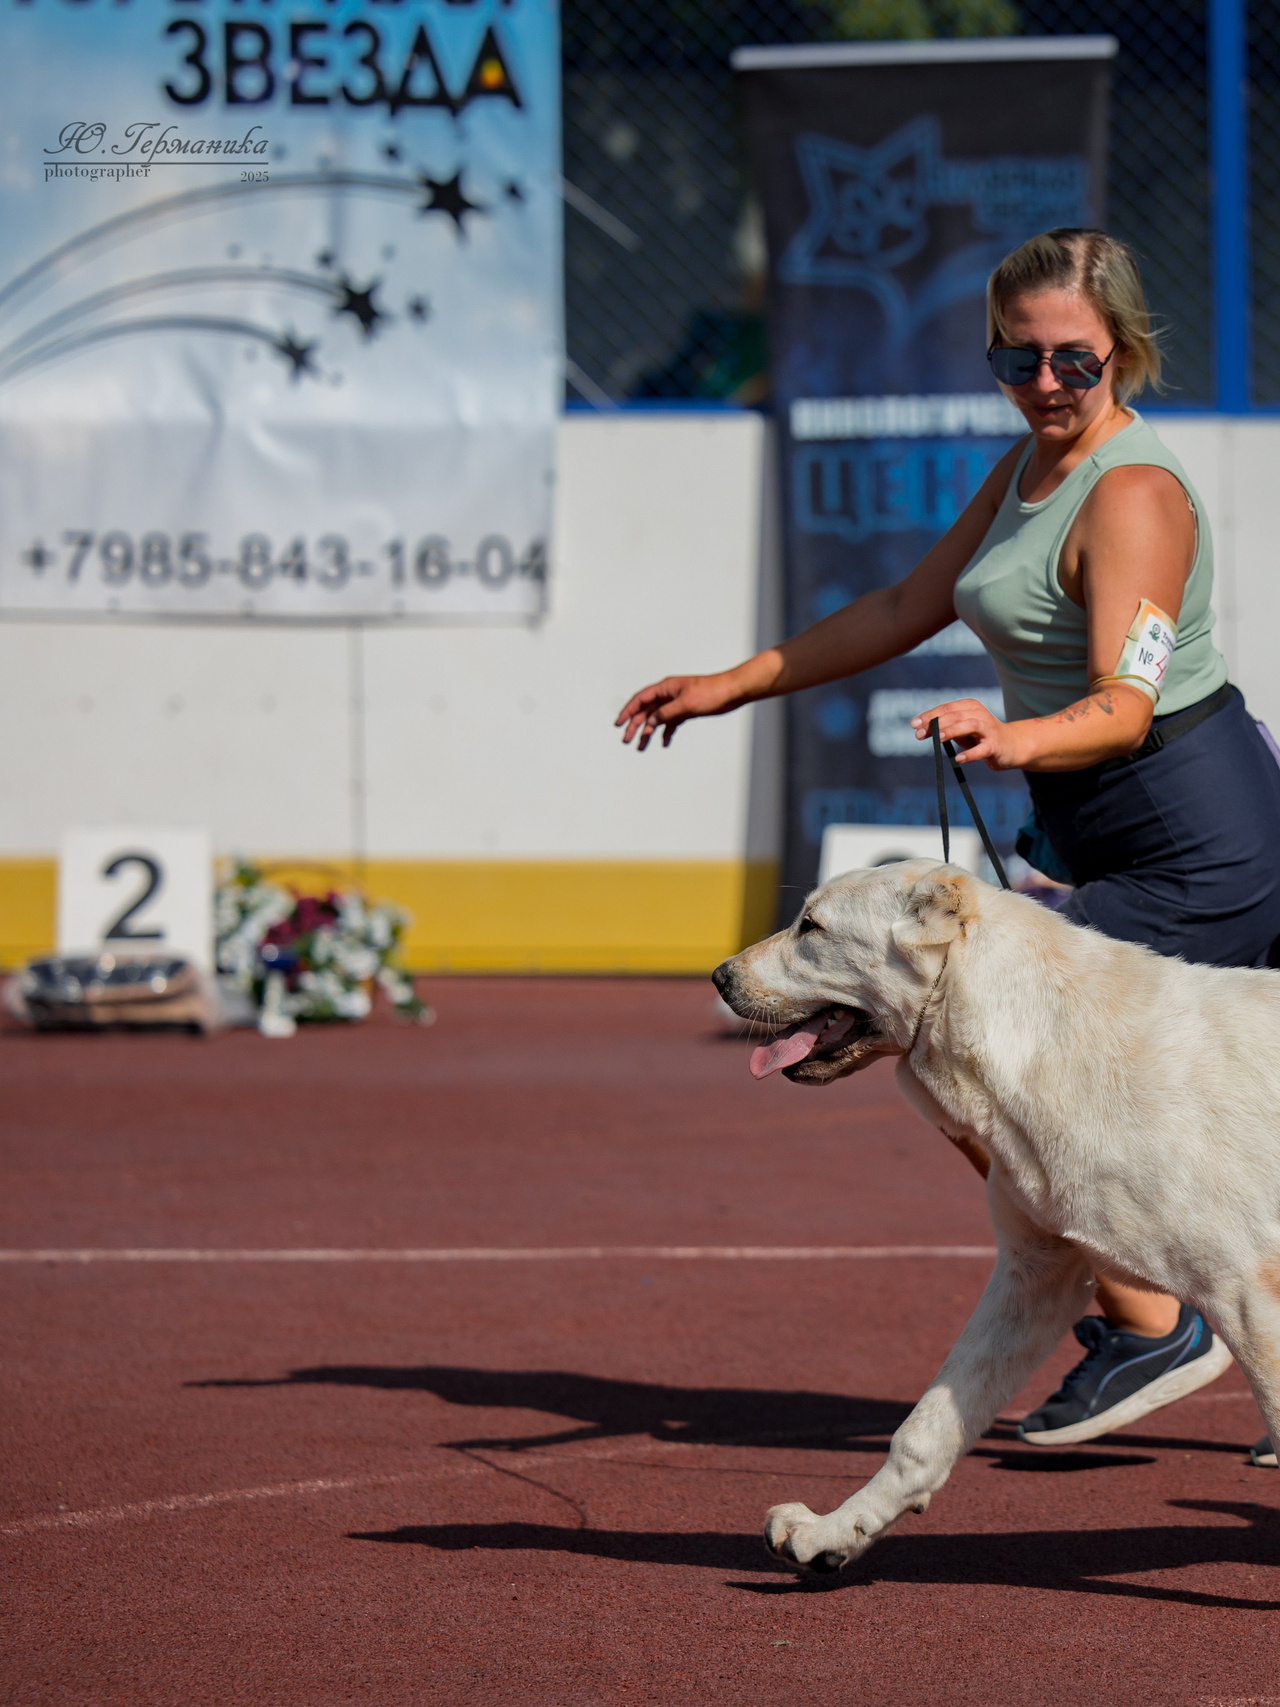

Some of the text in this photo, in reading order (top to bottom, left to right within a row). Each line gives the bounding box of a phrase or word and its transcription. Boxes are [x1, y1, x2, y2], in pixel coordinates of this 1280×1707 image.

[163, 19, 523, 114] ЗВЕЗДА
[21, 529, 549, 592] +7985-843-16-04
[101, 850, 165, 940] 2
